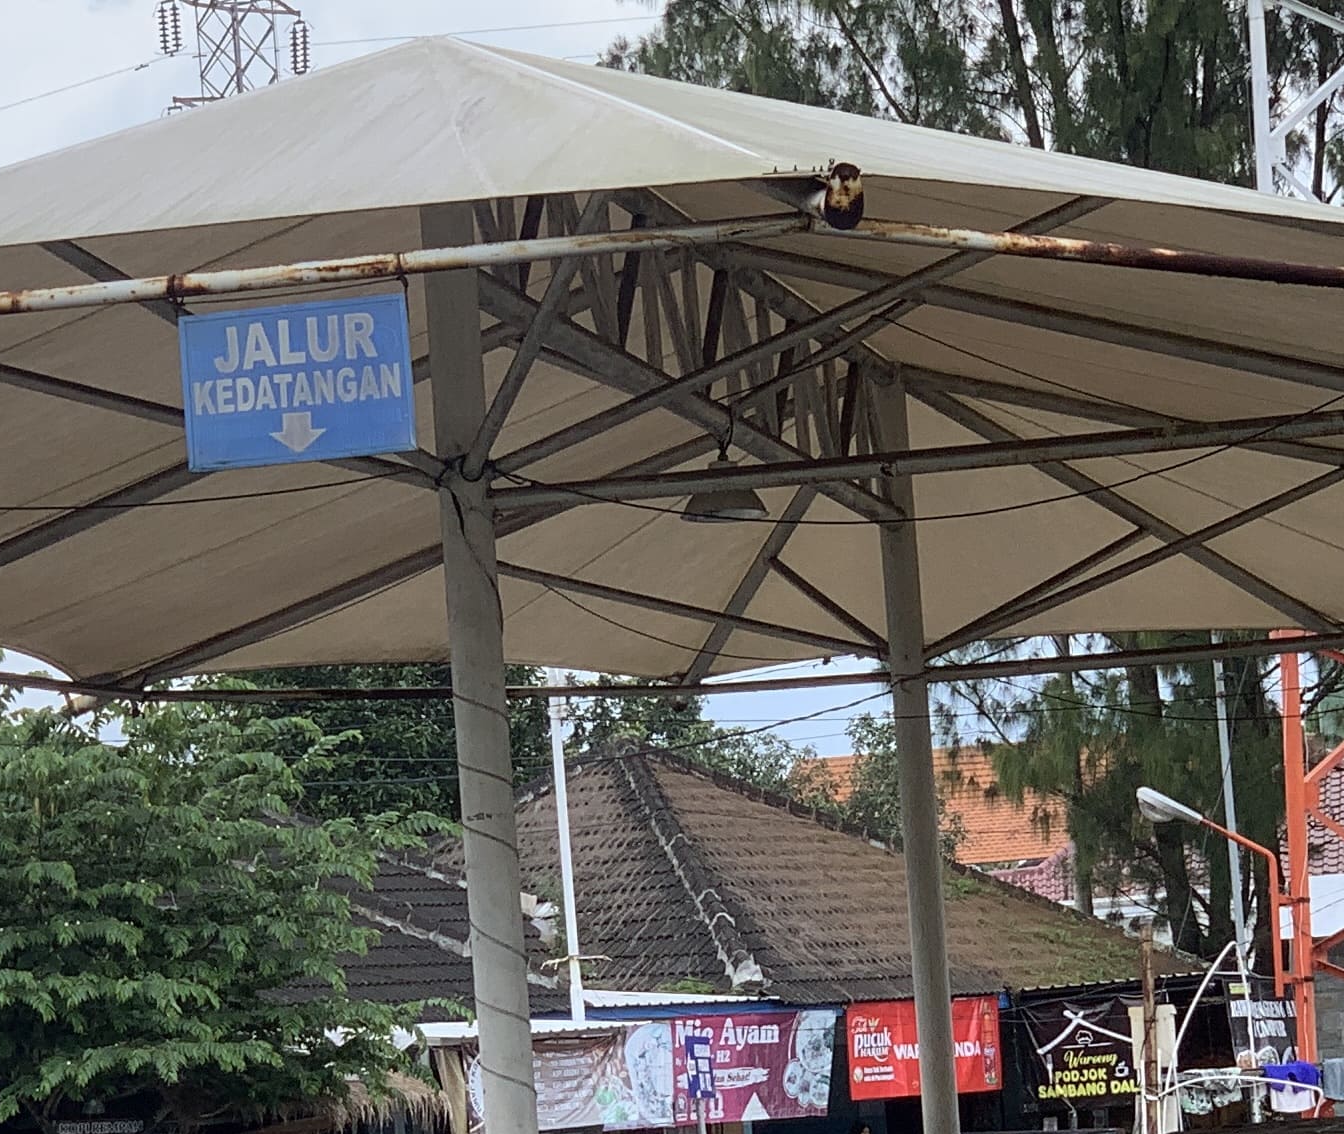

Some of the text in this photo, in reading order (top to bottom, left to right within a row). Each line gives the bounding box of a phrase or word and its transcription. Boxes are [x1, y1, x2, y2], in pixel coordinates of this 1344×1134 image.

[213, 312, 378, 373] JALUR
[192, 362, 401, 416] KEDATANGAN
[719, 1017, 779, 1050] Ayam
[1038, 1081, 1107, 1099] SAMBANG
[1055, 1068, 1108, 1083] PODJOK
